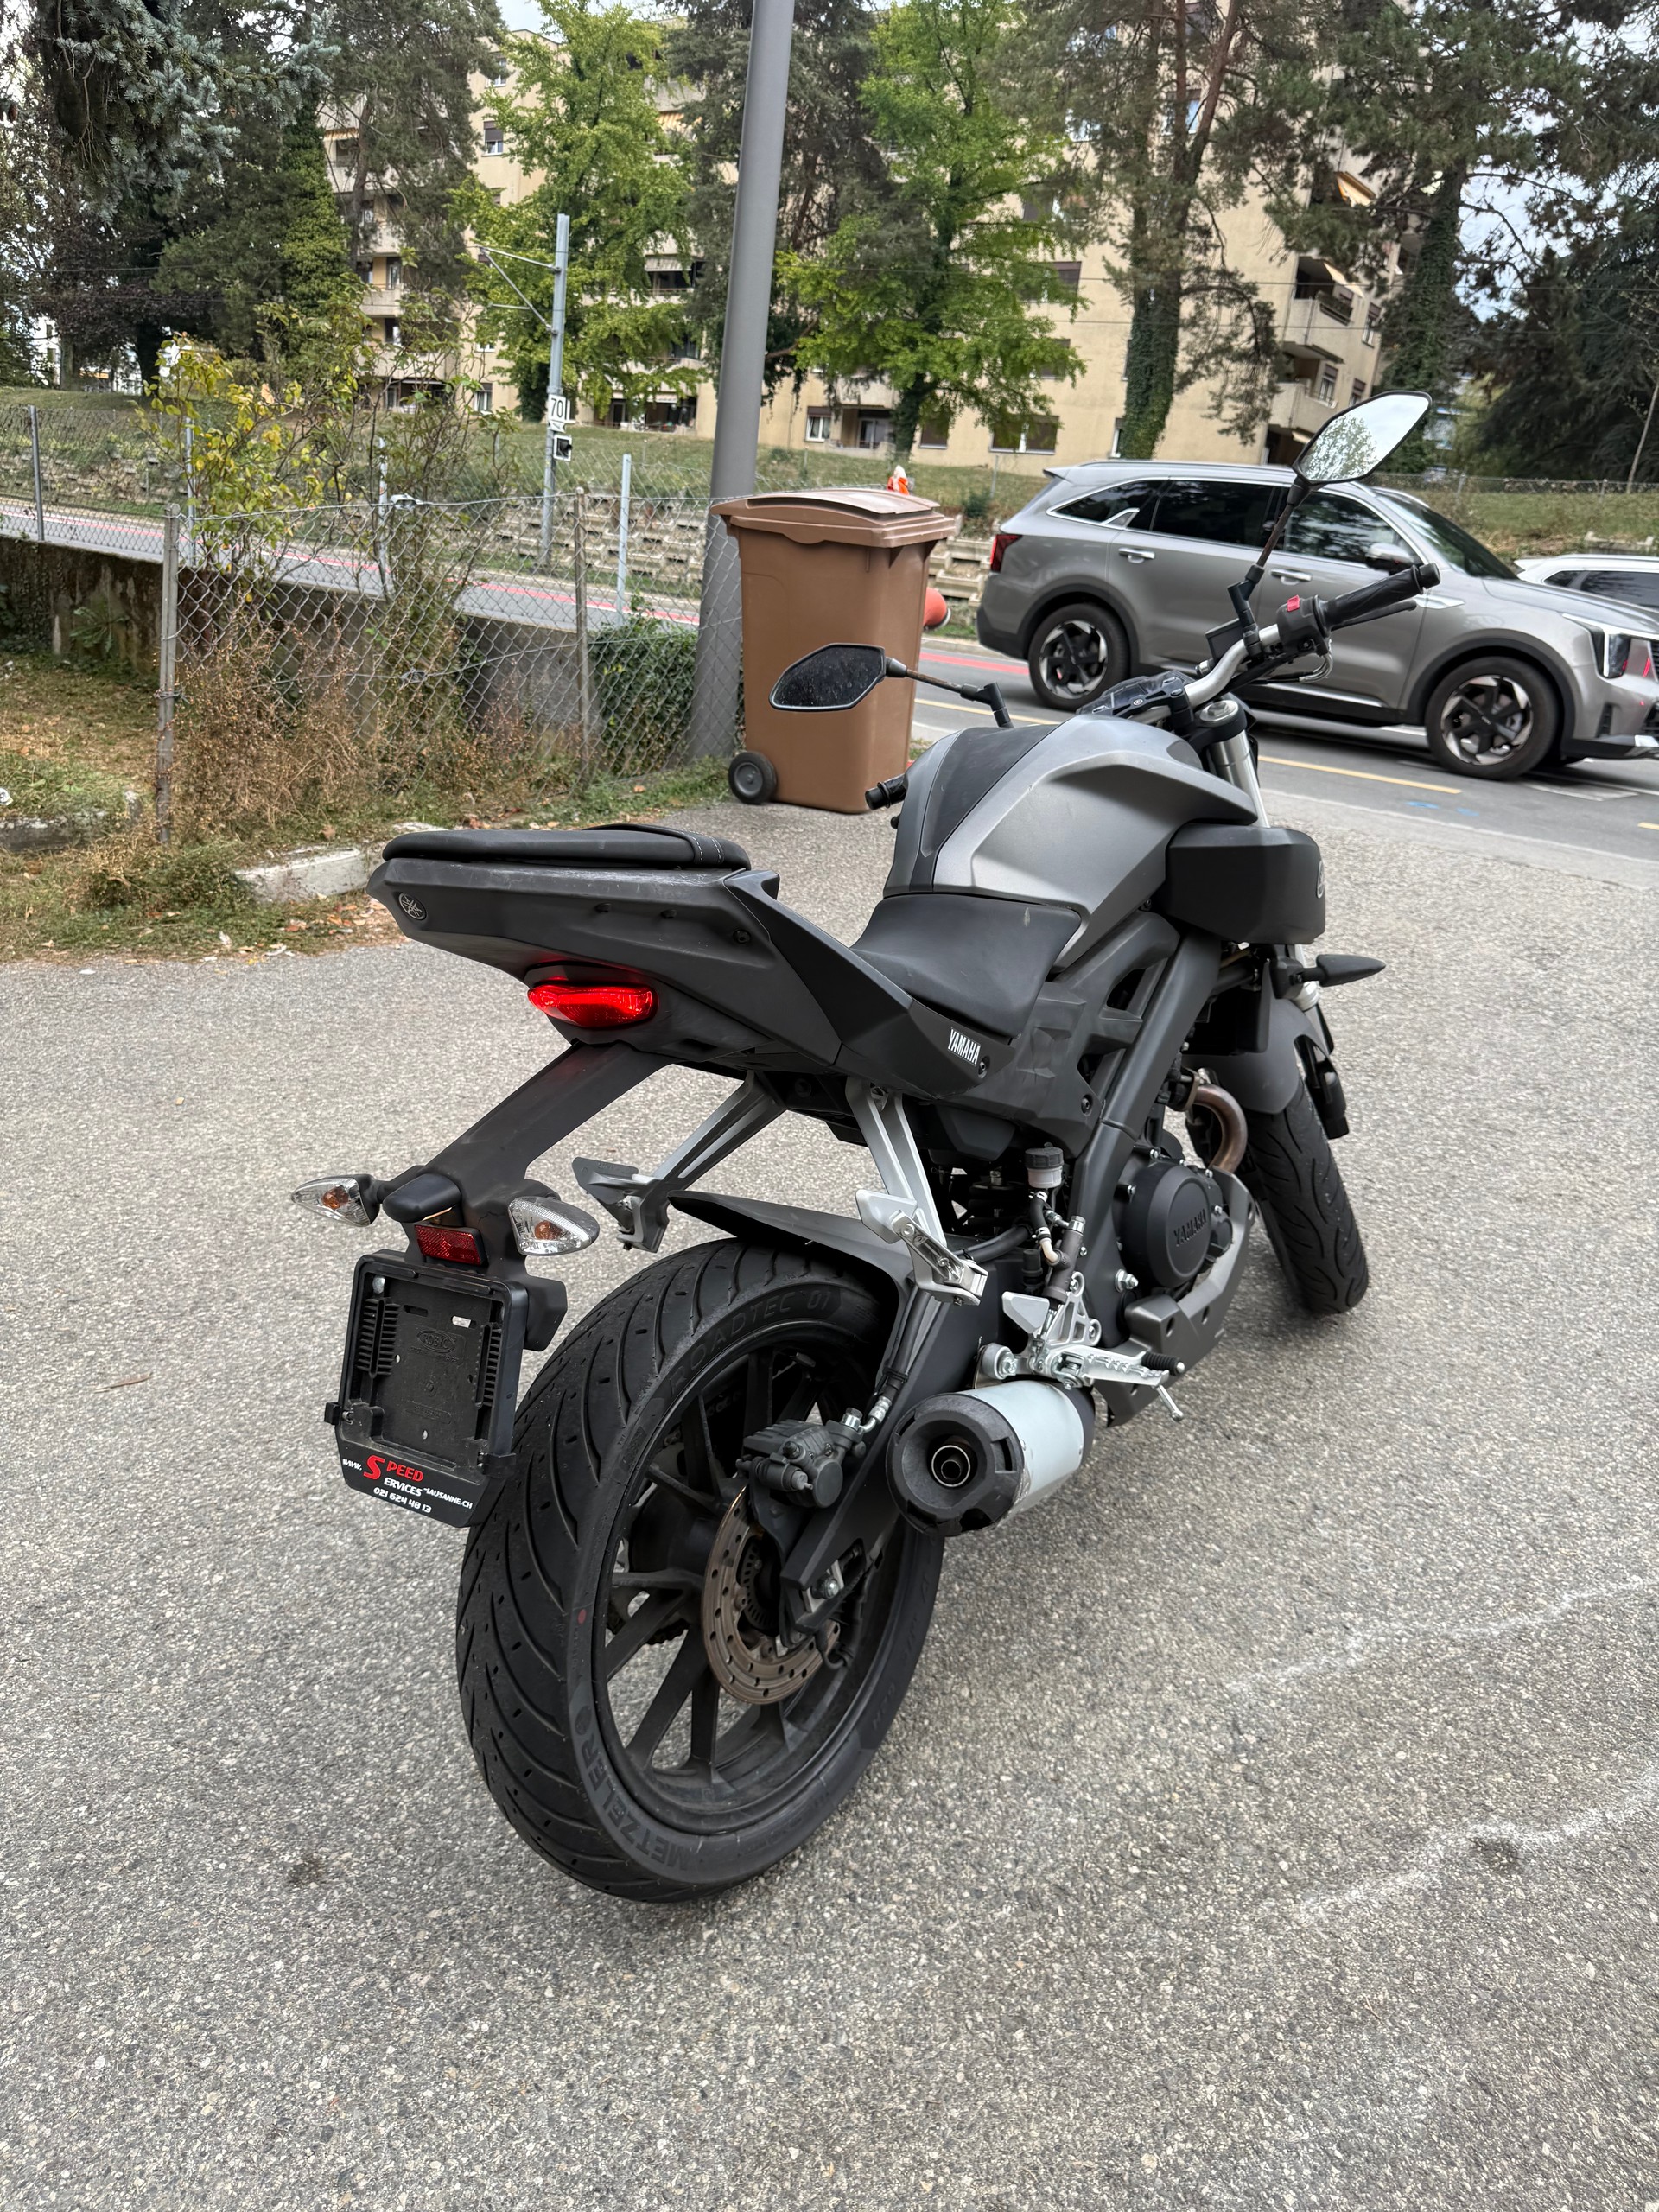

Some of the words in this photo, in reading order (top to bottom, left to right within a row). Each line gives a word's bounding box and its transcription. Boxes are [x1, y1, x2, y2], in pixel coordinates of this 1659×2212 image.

[551, 397, 564, 418] 70
[947, 1028, 982, 1065] YAMAHA
[1173, 1208, 1207, 1246] YAMAHA
[670, 1291, 796, 1395] ROADTEC
[373, 1486, 389, 1498] 021
[389, 1492, 408, 1505] 624
[408, 1499, 422, 1510] 48
[422, 1503, 432, 1513] 13
[581, 1733, 692, 1872] METZELER
